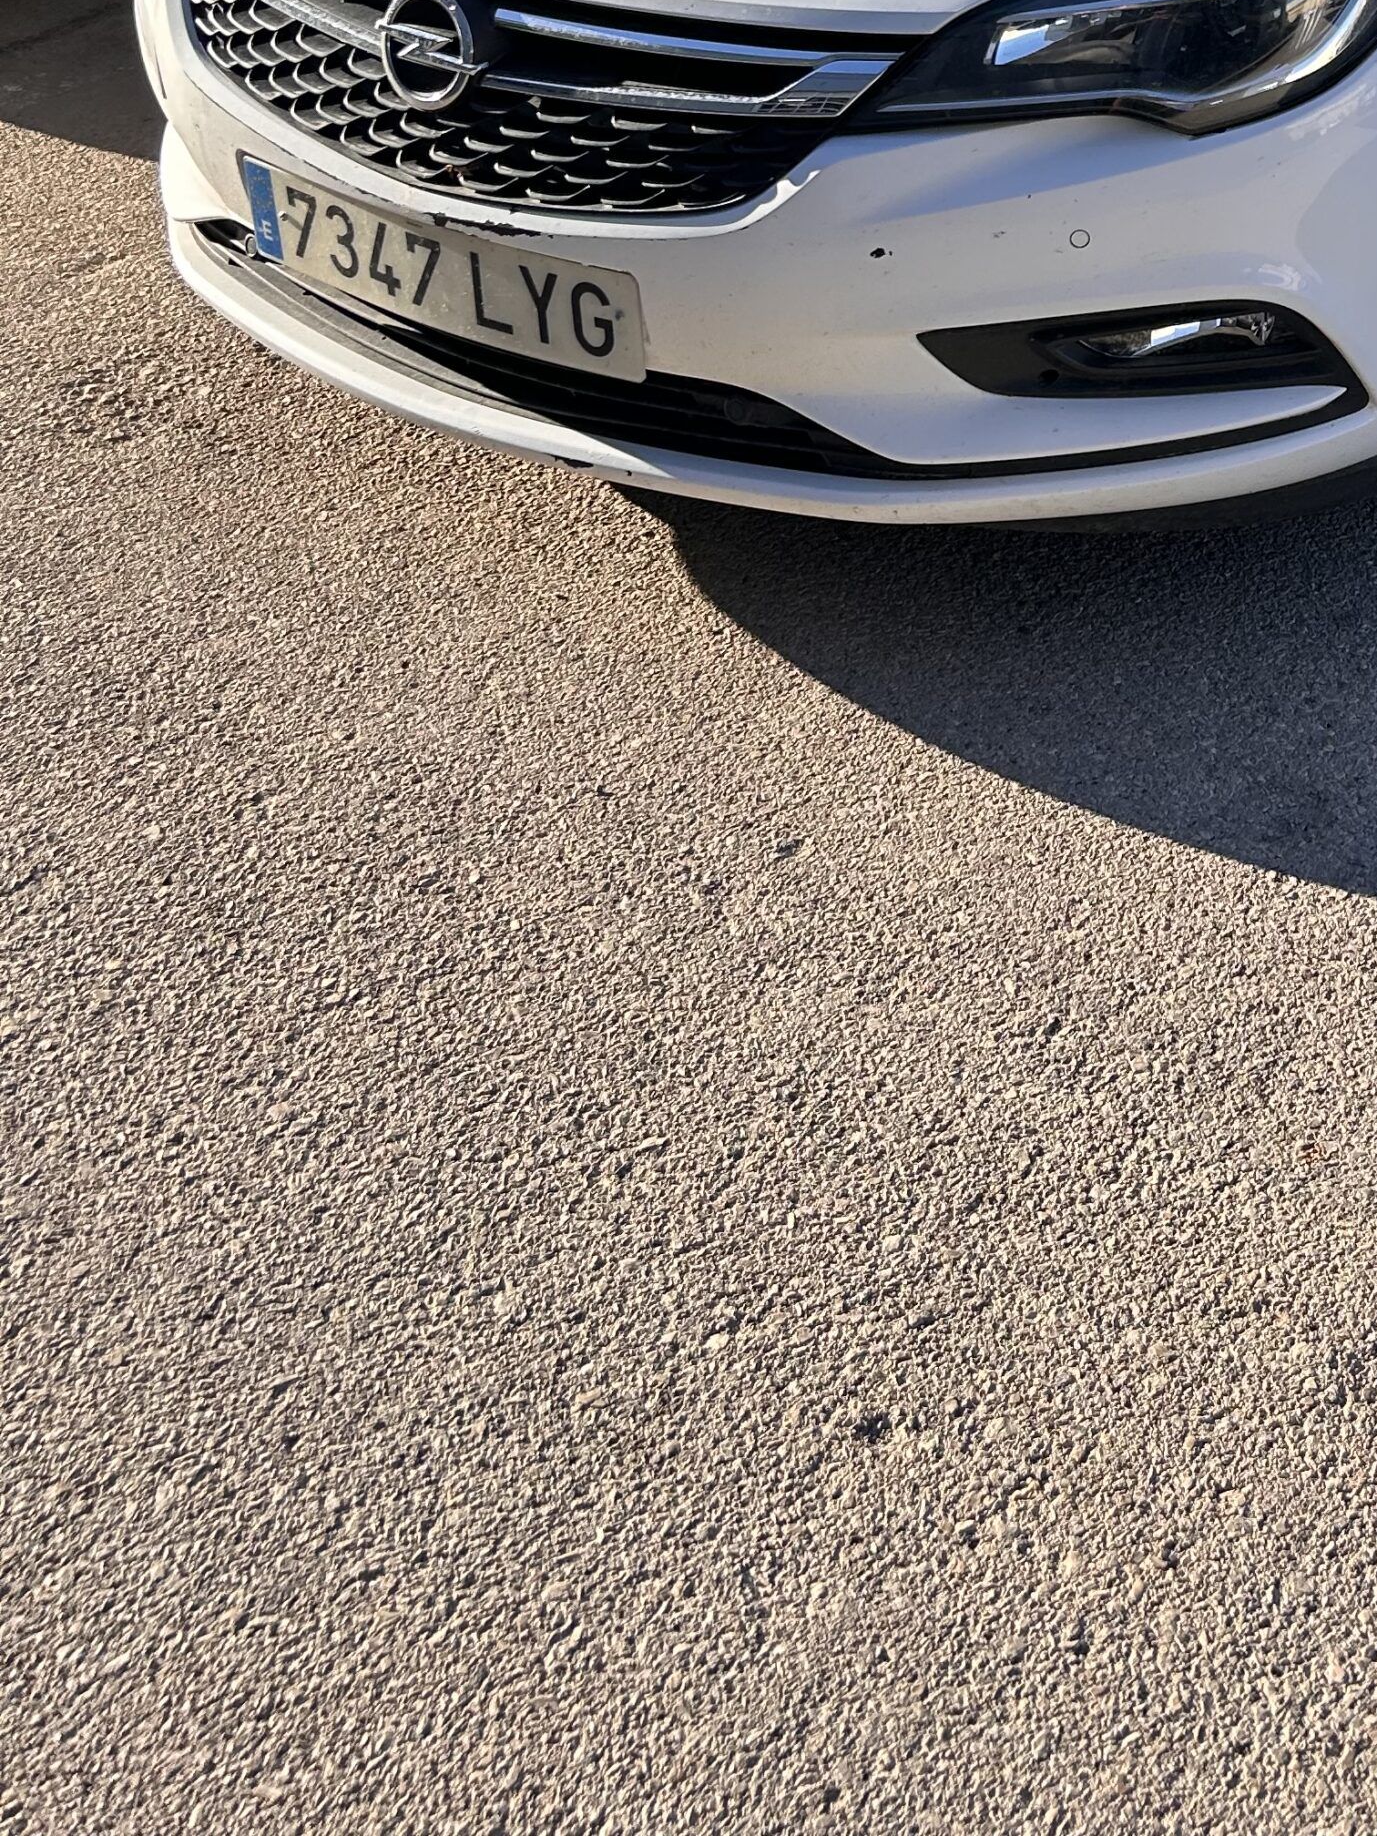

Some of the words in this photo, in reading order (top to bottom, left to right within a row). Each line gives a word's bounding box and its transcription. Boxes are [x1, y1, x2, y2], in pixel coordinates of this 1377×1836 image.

[260, 218, 274, 242] E
[286, 185, 441, 306] 7347
[469, 251, 615, 358] LYG
